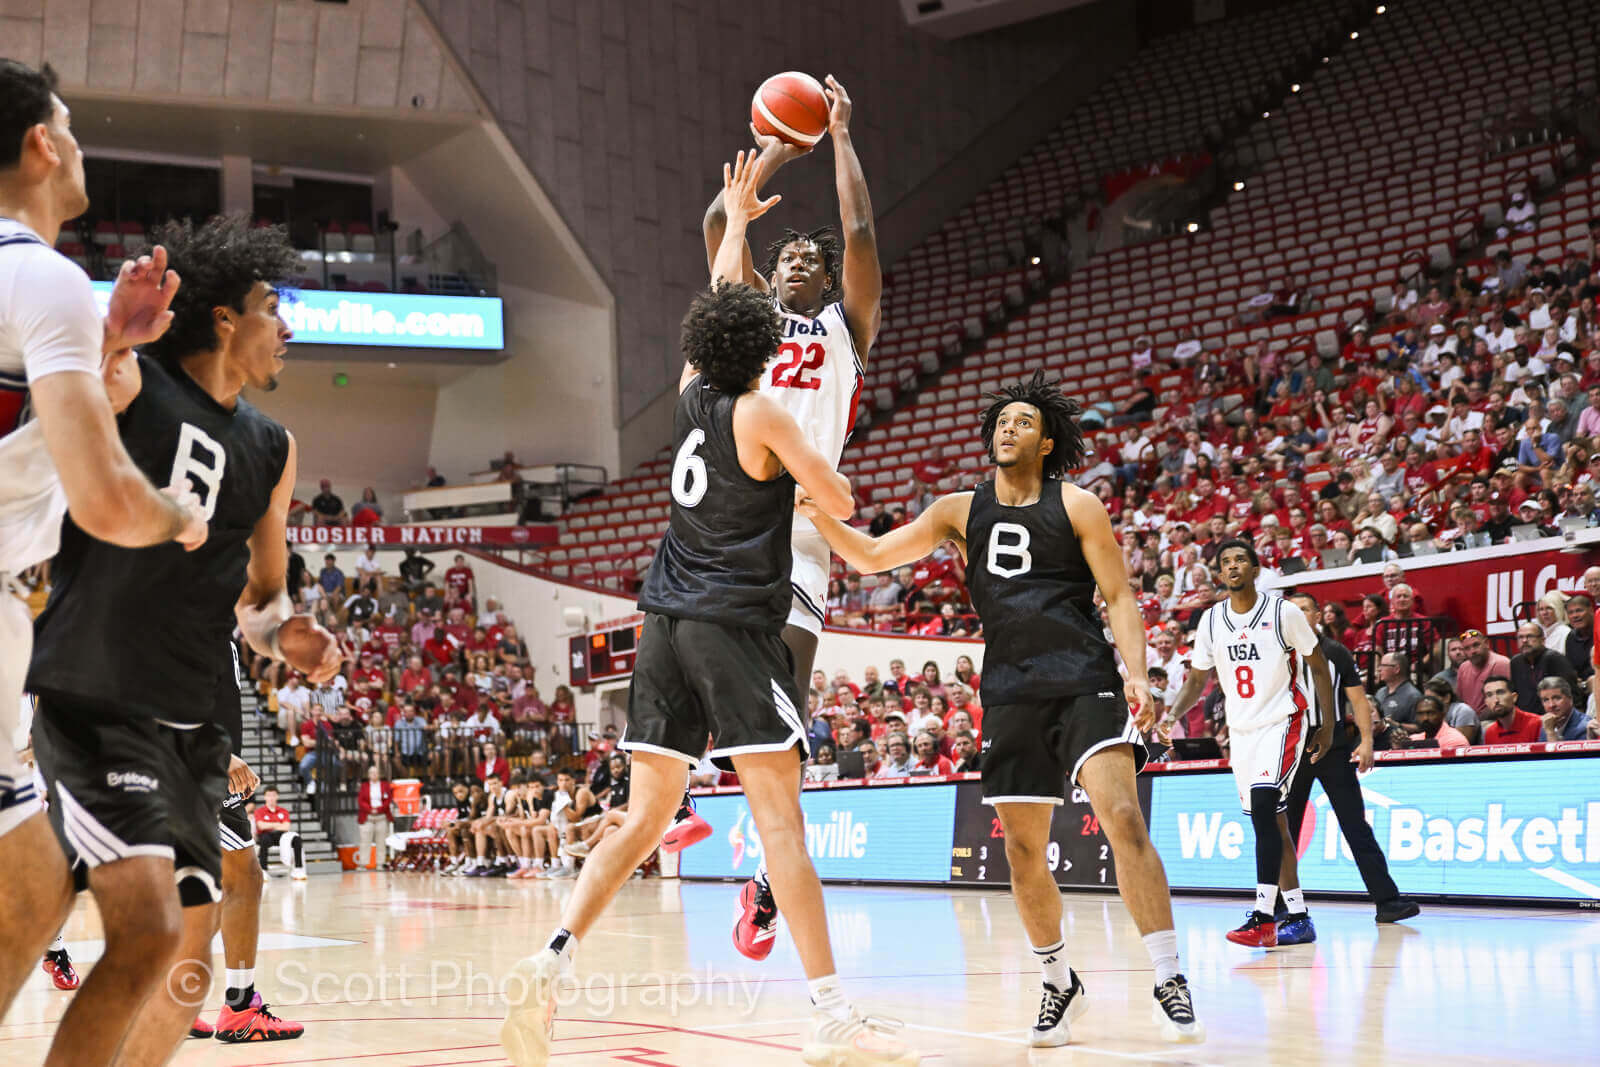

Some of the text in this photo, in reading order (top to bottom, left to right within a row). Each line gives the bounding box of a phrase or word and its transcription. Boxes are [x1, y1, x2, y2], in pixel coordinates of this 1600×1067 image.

[279, 299, 485, 338] thville.com
[771, 342, 826, 391] 22
[169, 421, 226, 523] B
[670, 427, 708, 508] 6
[285, 527, 385, 543] HOOSIER
[987, 523, 1032, 578] B
[1227, 643, 1261, 661] USA
[1235, 665, 1256, 699] 8
[745, 810, 868, 859] Shville
[1081, 814, 1100, 836] 24
[1177, 811, 1244, 859] We
[979, 845, 988, 860] 3
[1099, 845, 1109, 860] 2
[977, 865, 987, 880] 2
[1099, 868, 1107, 883] 1
